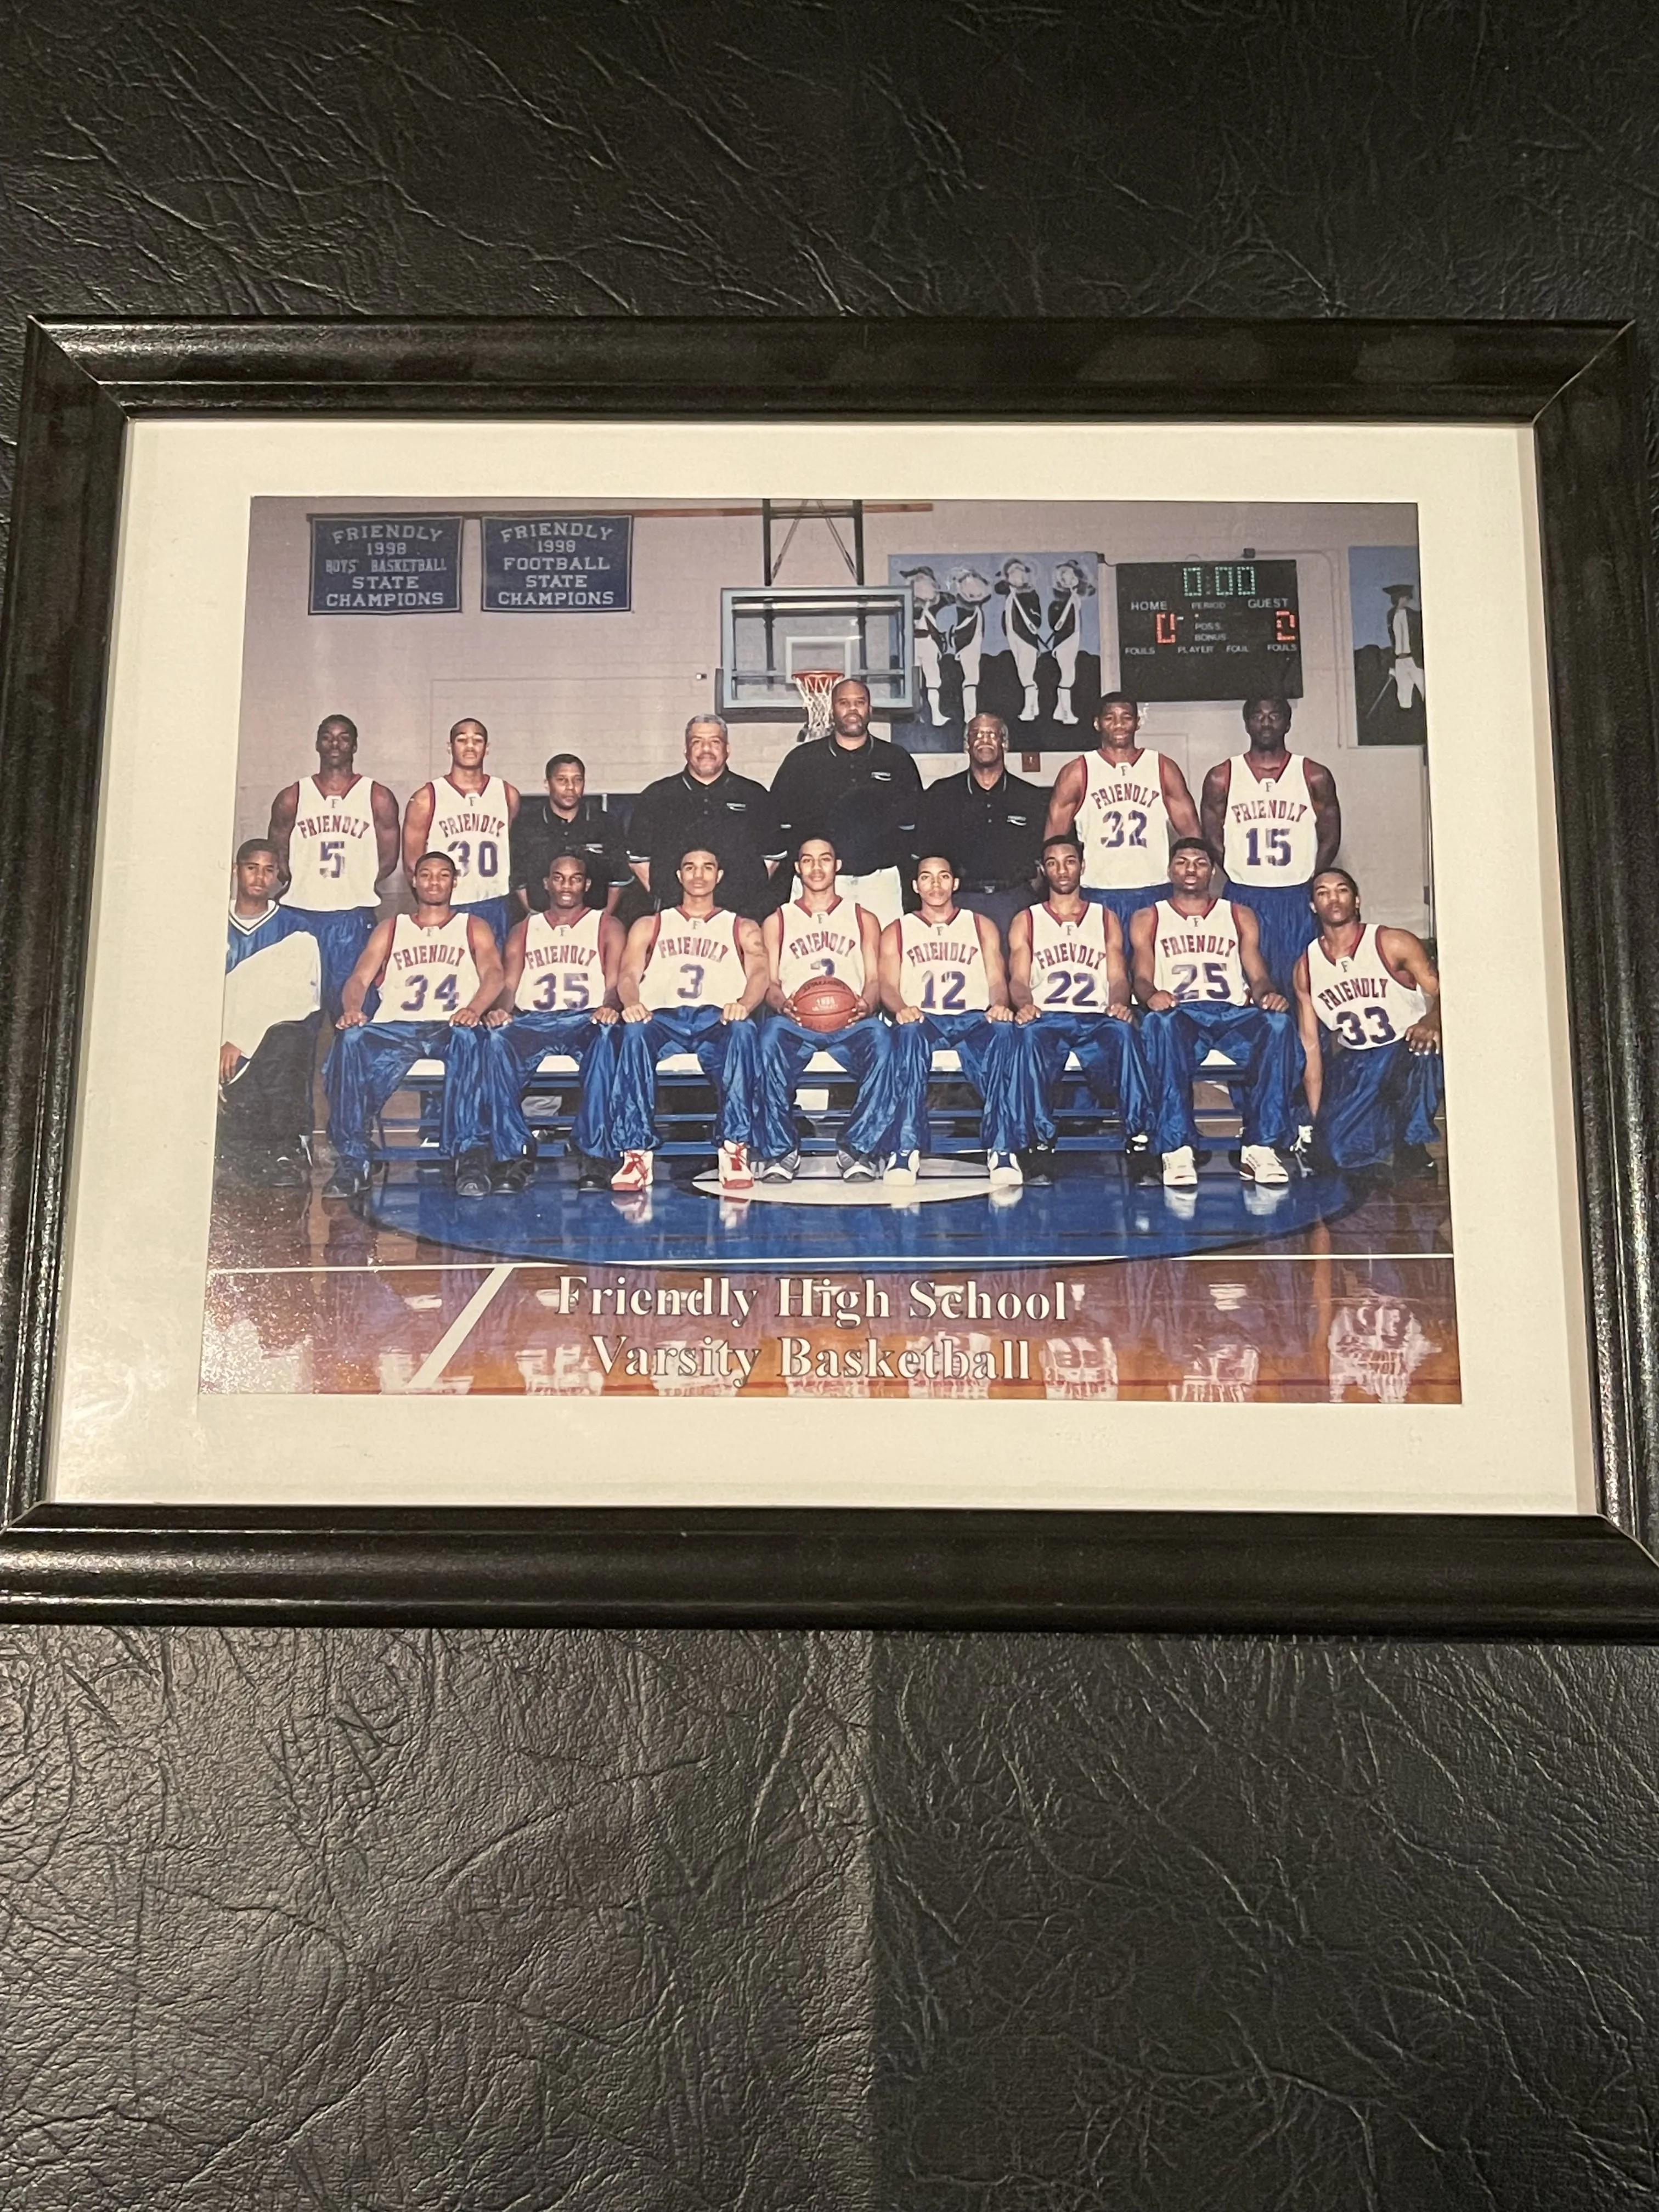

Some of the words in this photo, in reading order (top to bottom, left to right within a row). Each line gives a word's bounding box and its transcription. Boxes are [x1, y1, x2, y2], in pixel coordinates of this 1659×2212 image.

[332, 524, 443, 544] FRIENDLY
[500, 522, 614, 543] FRIENDLY
[367, 542, 407, 556] 1998
[538, 540, 576, 553] 1998
[371, 558, 447, 572] BASKETBALL
[504, 557, 611, 571] FOOTBALL
[352, 576, 420, 589] STATE
[526, 575, 588, 588] STATE
[326, 592, 444, 606] CHAMPIONS
[498, 591, 614, 605] CHAMPIONS
[1131, 600, 1167, 611] HOME
[1248, 598, 1288, 608] GUEST
[1091, 783, 1160, 809] FRIENDLY
[1231, 799, 1307, 823] FRIENDLY
[297, 815, 370, 839] FRIENDLY
[439, 813, 505, 838] FRIENDLY
[1101, 810, 1147, 848] 32
[319, 841, 346, 878] 5
[447, 840, 498, 877] 30
[1246, 828, 1291, 866] 15
[526, 945, 597, 969] FRIENDLY
[658, 936, 729, 963] FRIENDLY
[789, 930, 856, 959] FRIENDLY
[906, 942, 978, 967] FRIENDLY
[1160, 934, 1236, 958] FRIENDLY
[393, 945, 465, 970] FRIENDLY
[400, 974, 460, 1012] 34
[533, 973, 589, 1011] 35
[677, 963, 704, 999] 3
[921, 970, 966, 1010] 12
[1043, 970, 1099, 1006] 22
[1172, 963, 1231, 1000] 25
[1317, 978, 1389, 1011] FRIENDLY
[1336, 1006, 1397, 1046] 33
[555, 1275, 759, 1328] Friendly
[776, 1277, 891, 1329] High
[909, 1279, 1068, 1321] School
[590, 1335, 762, 1388] Varsity
[777, 1336, 1032, 1380] Basketball
